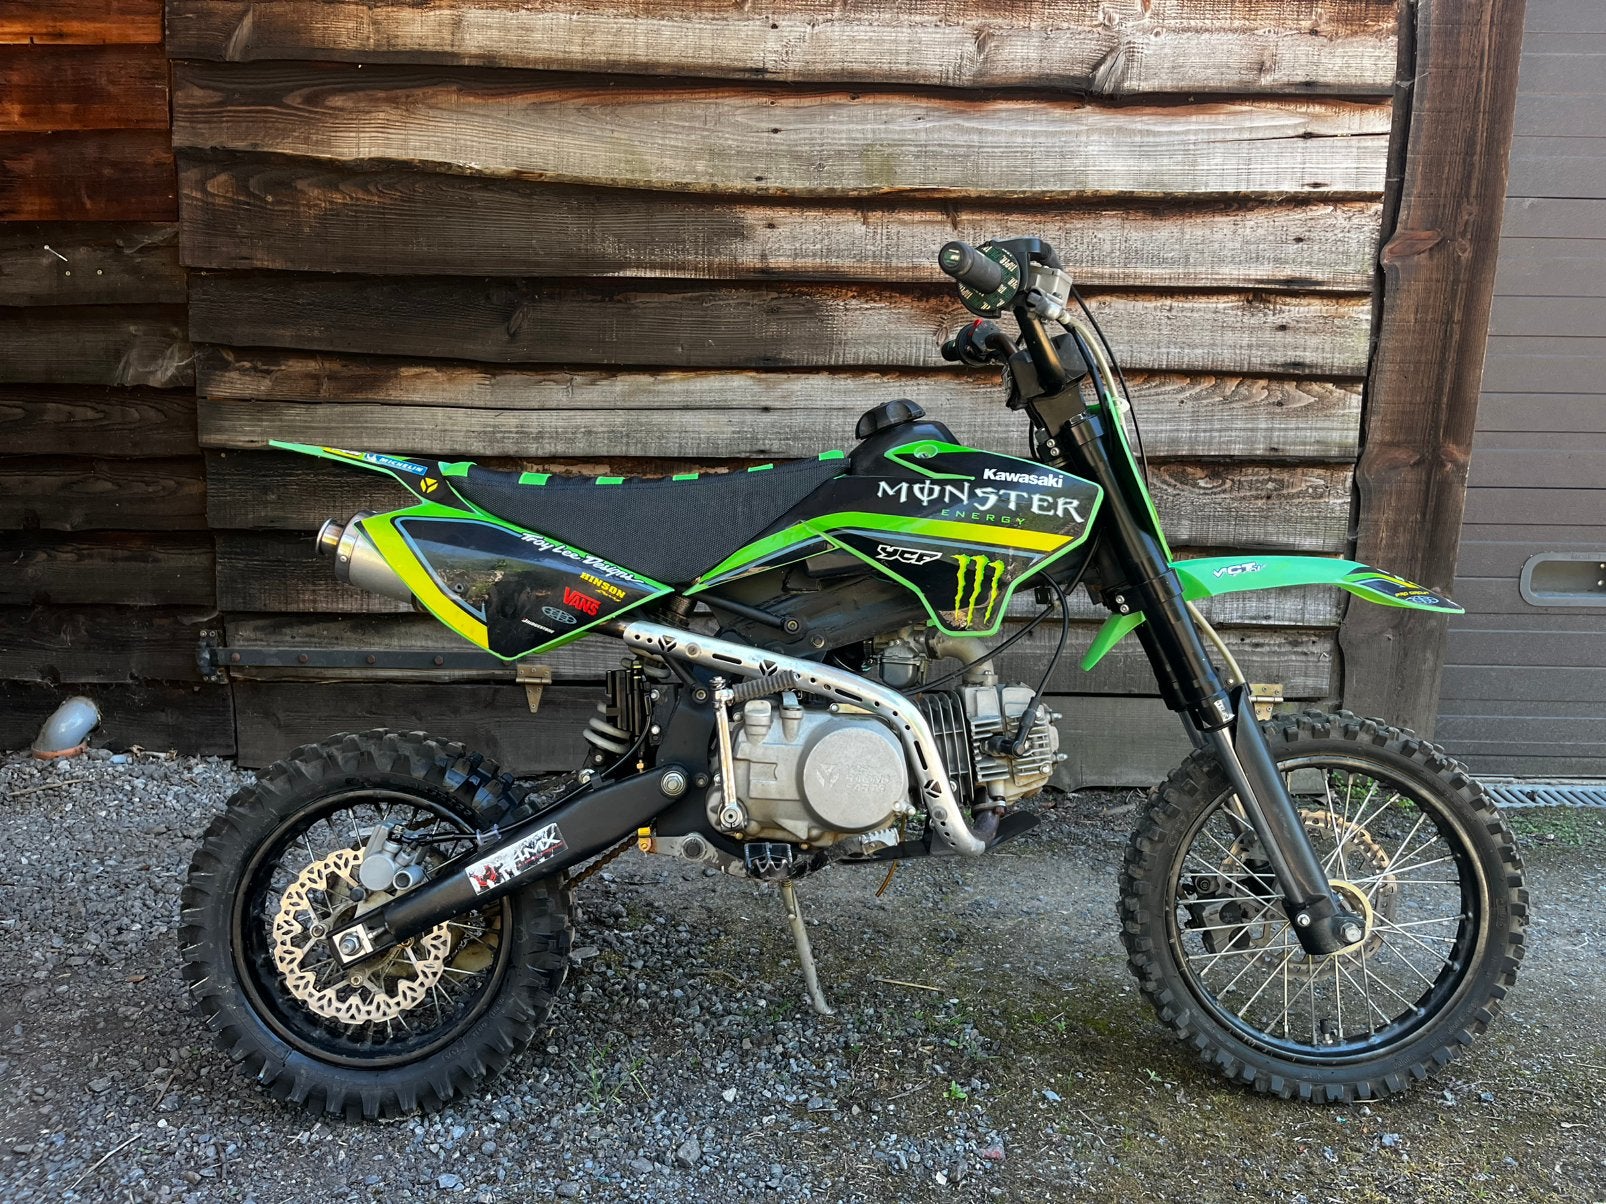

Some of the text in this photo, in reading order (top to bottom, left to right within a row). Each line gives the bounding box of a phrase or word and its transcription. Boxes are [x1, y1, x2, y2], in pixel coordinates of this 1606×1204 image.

[379, 457, 424, 473] MICHELIN
[983, 468, 1064, 488] Kawasaki
[876, 479, 1085, 523] MONSTER
[941, 508, 1027, 526] ENERGY
[521, 532, 645, 584] Troy Lee Designs
[579, 572, 627, 599] HINSON
[563, 586, 602, 617] VANS
